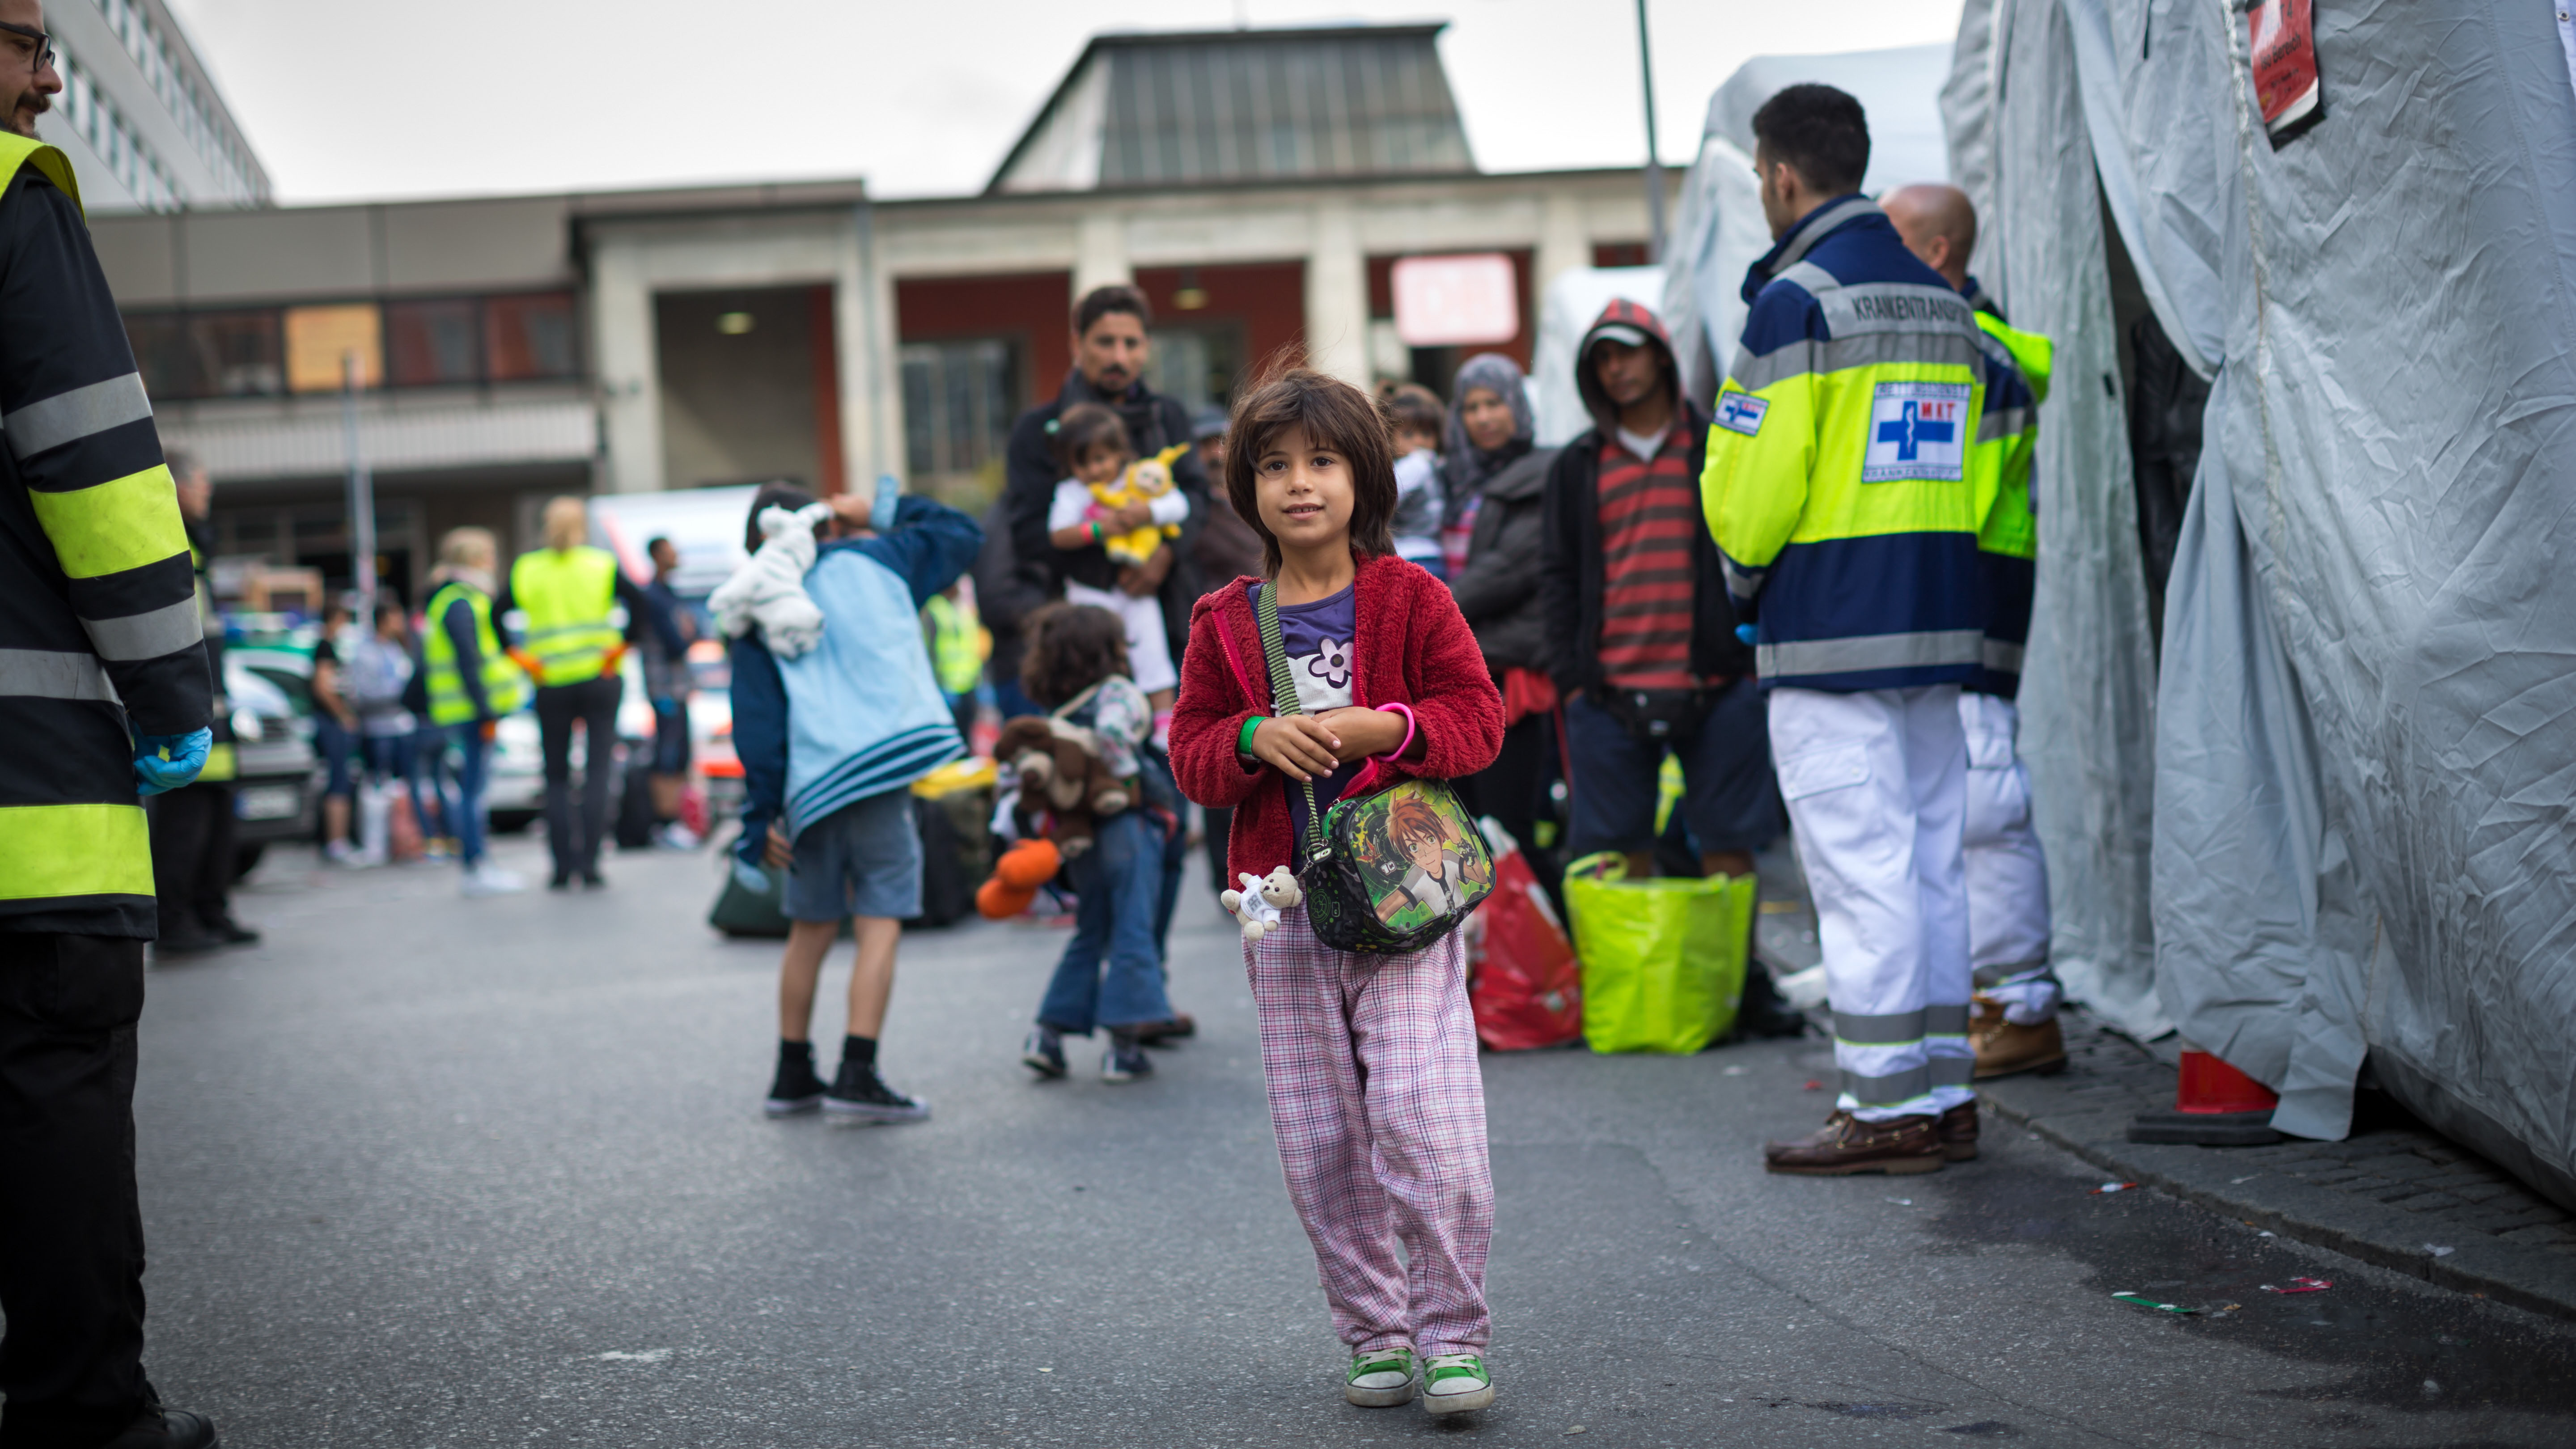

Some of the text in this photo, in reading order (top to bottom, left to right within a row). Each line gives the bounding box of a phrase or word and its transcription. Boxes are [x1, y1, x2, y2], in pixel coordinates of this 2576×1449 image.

[2272, 30, 2302, 64] Bereich
[1313, 847, 1332, 861] 10
[1381, 860, 1397, 876] 10
